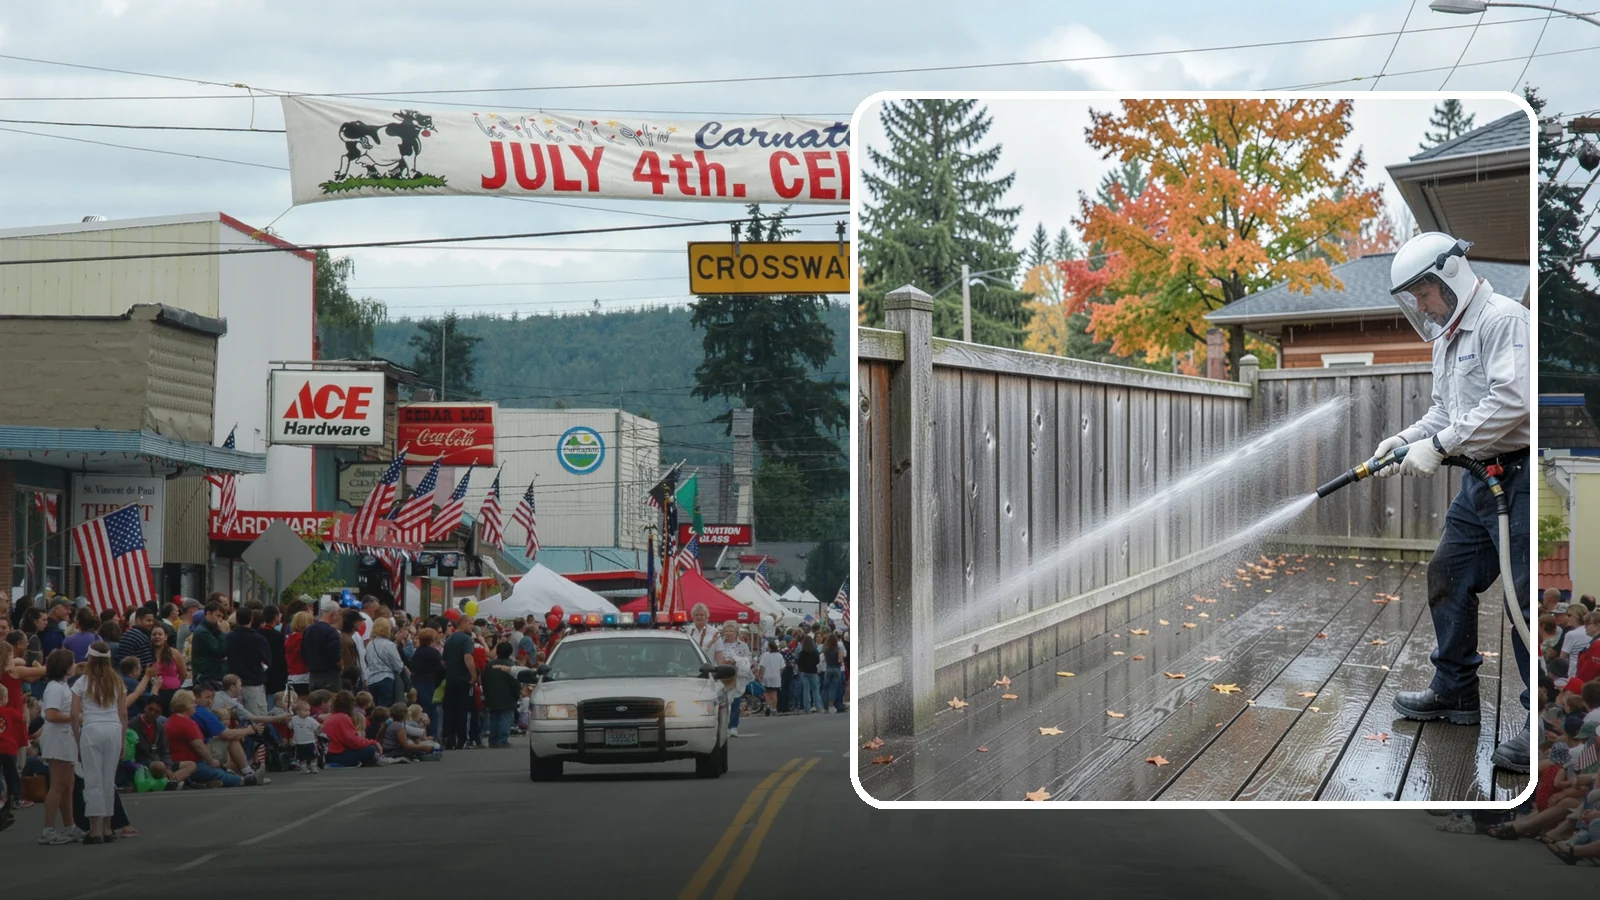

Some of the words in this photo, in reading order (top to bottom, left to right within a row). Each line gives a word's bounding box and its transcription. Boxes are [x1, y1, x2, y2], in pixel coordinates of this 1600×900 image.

[695, 121, 850, 149] Carnat
[481, 141, 605, 192] JULY
[632, 150, 746, 197] 4th.
[697, 254, 850, 280] CROSSWA
[282, 380, 373, 420] ACE
[405, 409, 452, 421] CEDAR
[461, 409, 485, 421] LOG
[283, 421, 370, 437] Hardware
[416, 428, 477, 447] Coca-Cola
[353, 467, 384, 480] Simpl
[83, 485, 93, 494] St.
[95, 485, 124, 494] Vincent
[126, 485, 135, 494] de
[137, 485, 155, 495] Paul
[688, 526, 741, 535] CRNATION
[699, 535, 730, 544] GLASS
